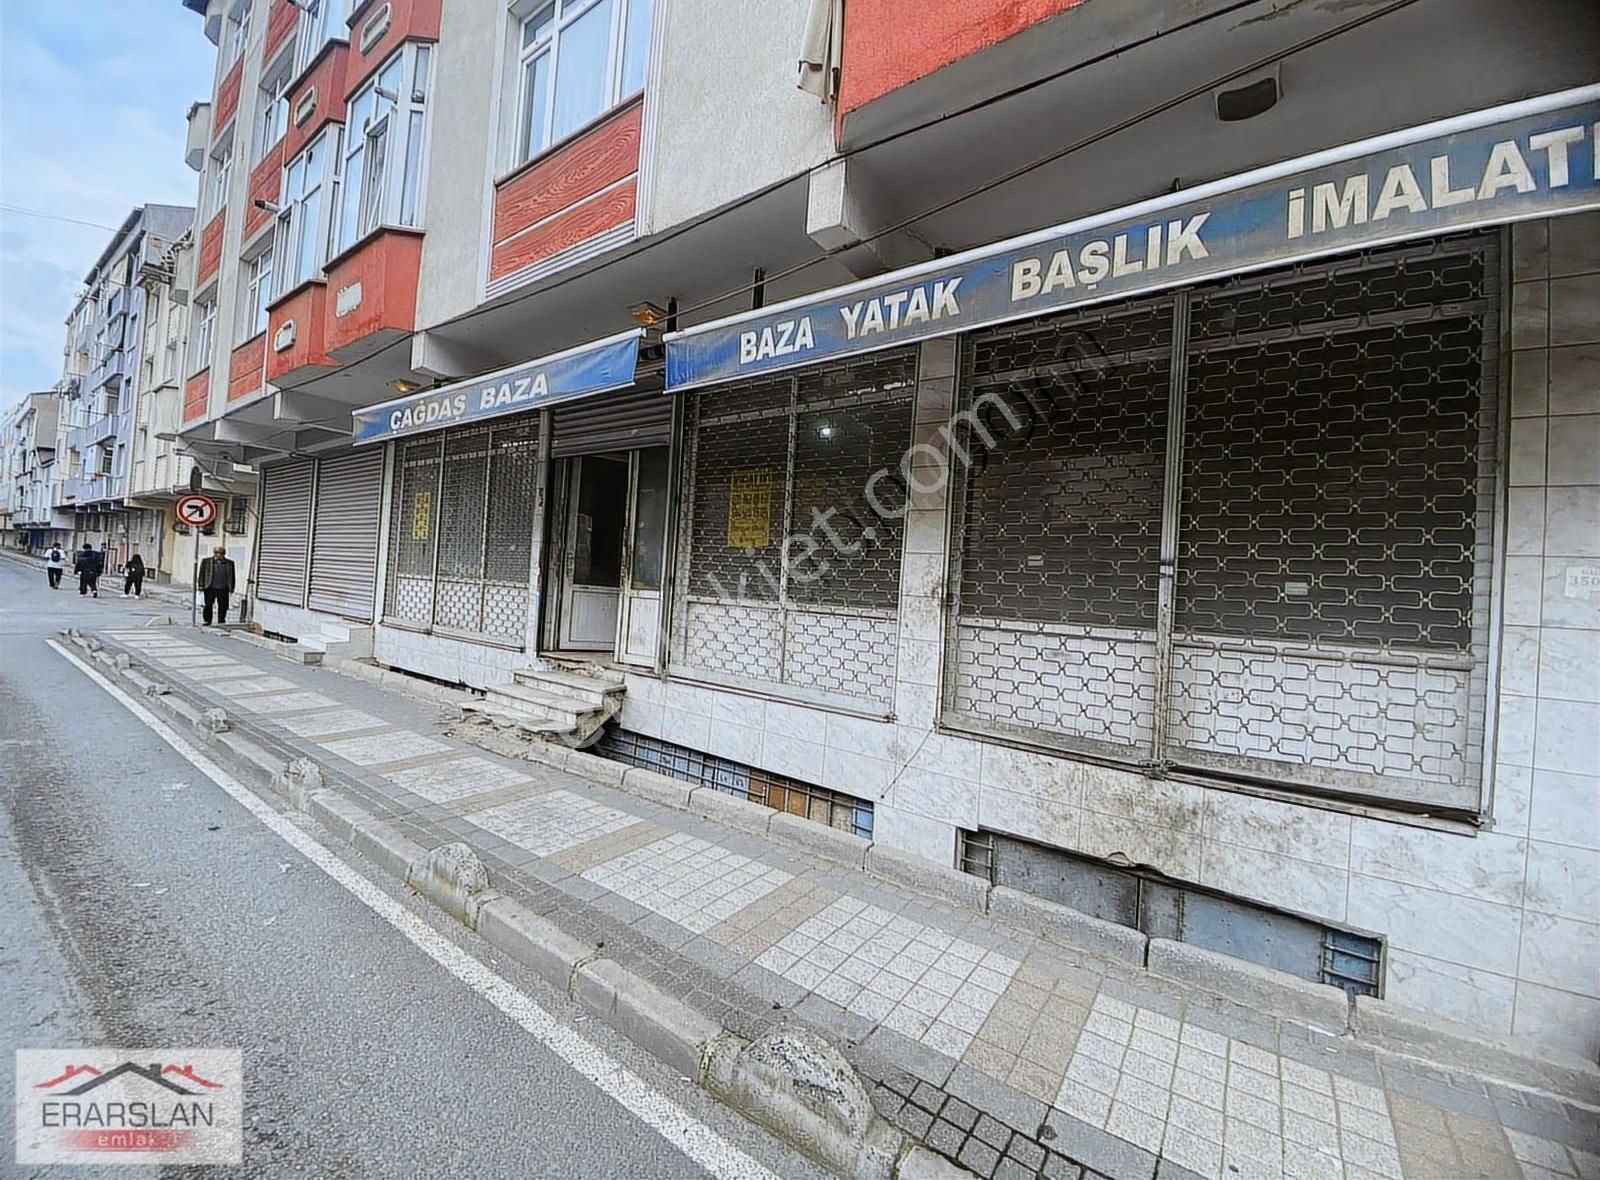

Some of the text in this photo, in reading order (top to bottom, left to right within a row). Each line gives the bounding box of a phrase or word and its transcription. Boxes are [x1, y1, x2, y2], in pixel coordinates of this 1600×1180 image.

[739, 317, 816, 365] BAZA
[839, 275, 963, 340] YATAK
[1011, 211, 1212, 301] BAŞLIK
[389, 371, 549, 435] ÇAĞDAŞ BAZA
